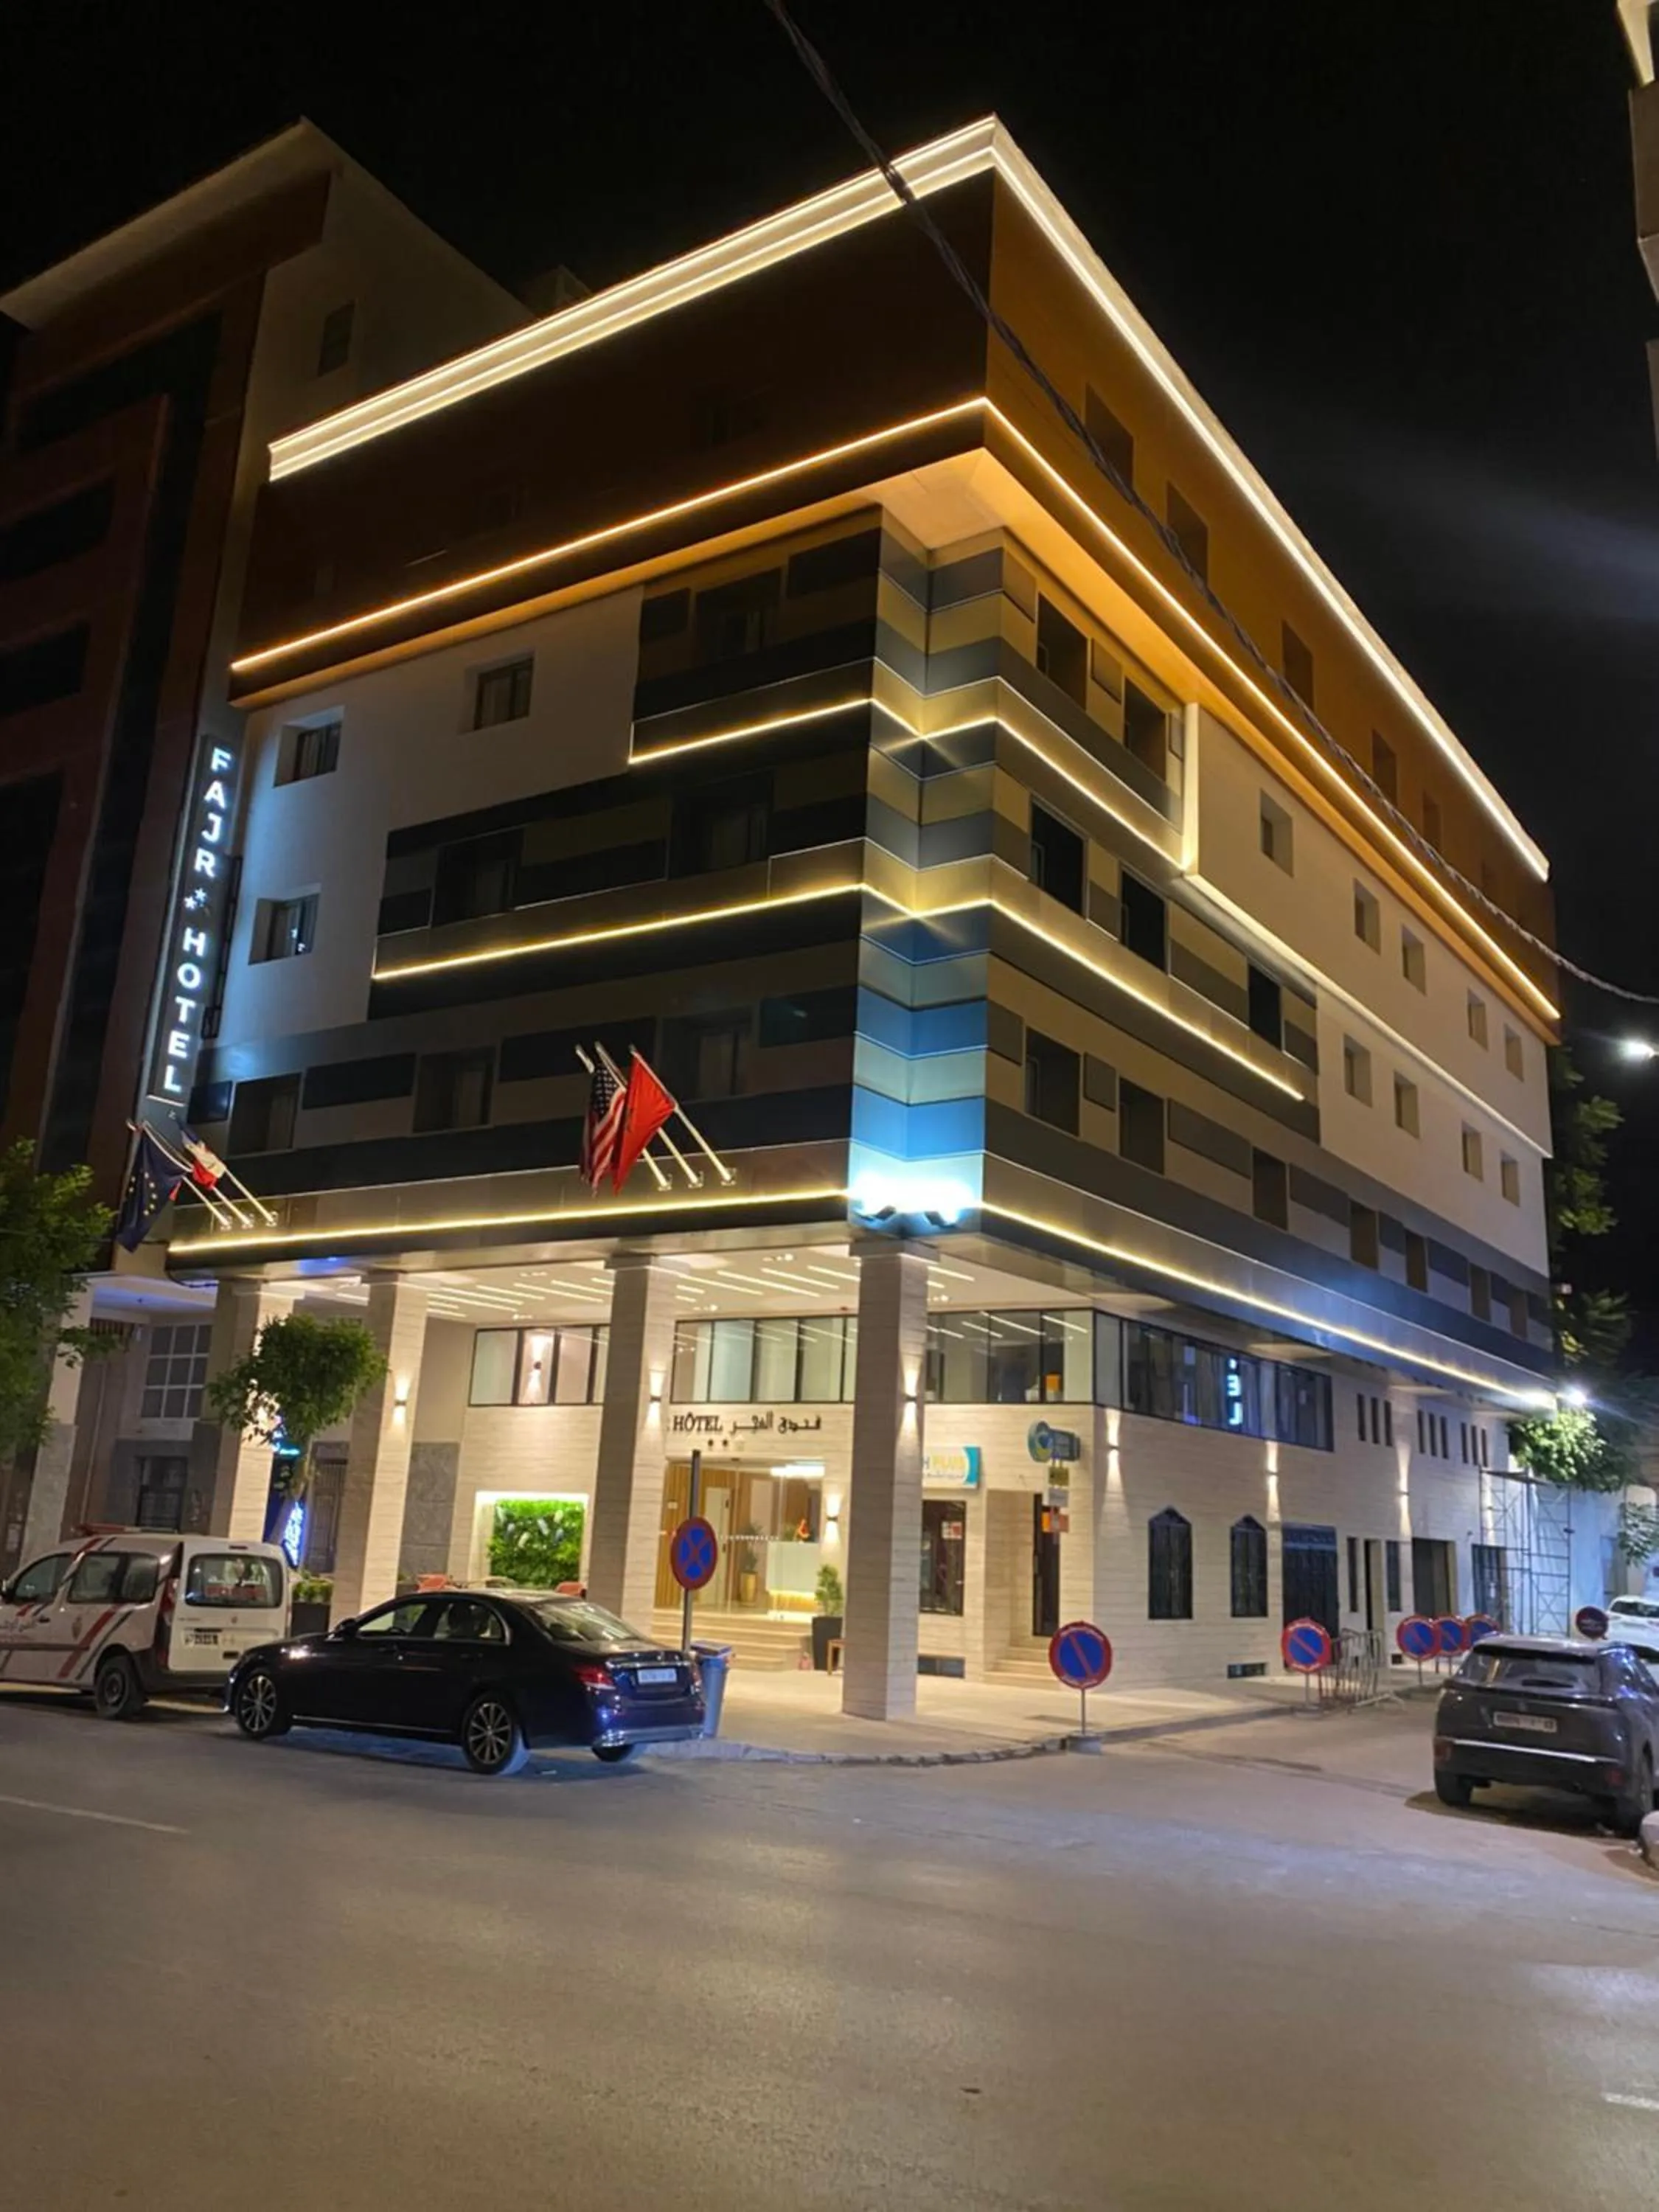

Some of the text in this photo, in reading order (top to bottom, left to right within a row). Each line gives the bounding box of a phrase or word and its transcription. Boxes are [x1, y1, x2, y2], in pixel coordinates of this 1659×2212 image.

[195, 748, 232, 878] FAJR
[163, 927, 206, 1093] HOTEL
[672, 1411, 723, 1432] HÔTEL
